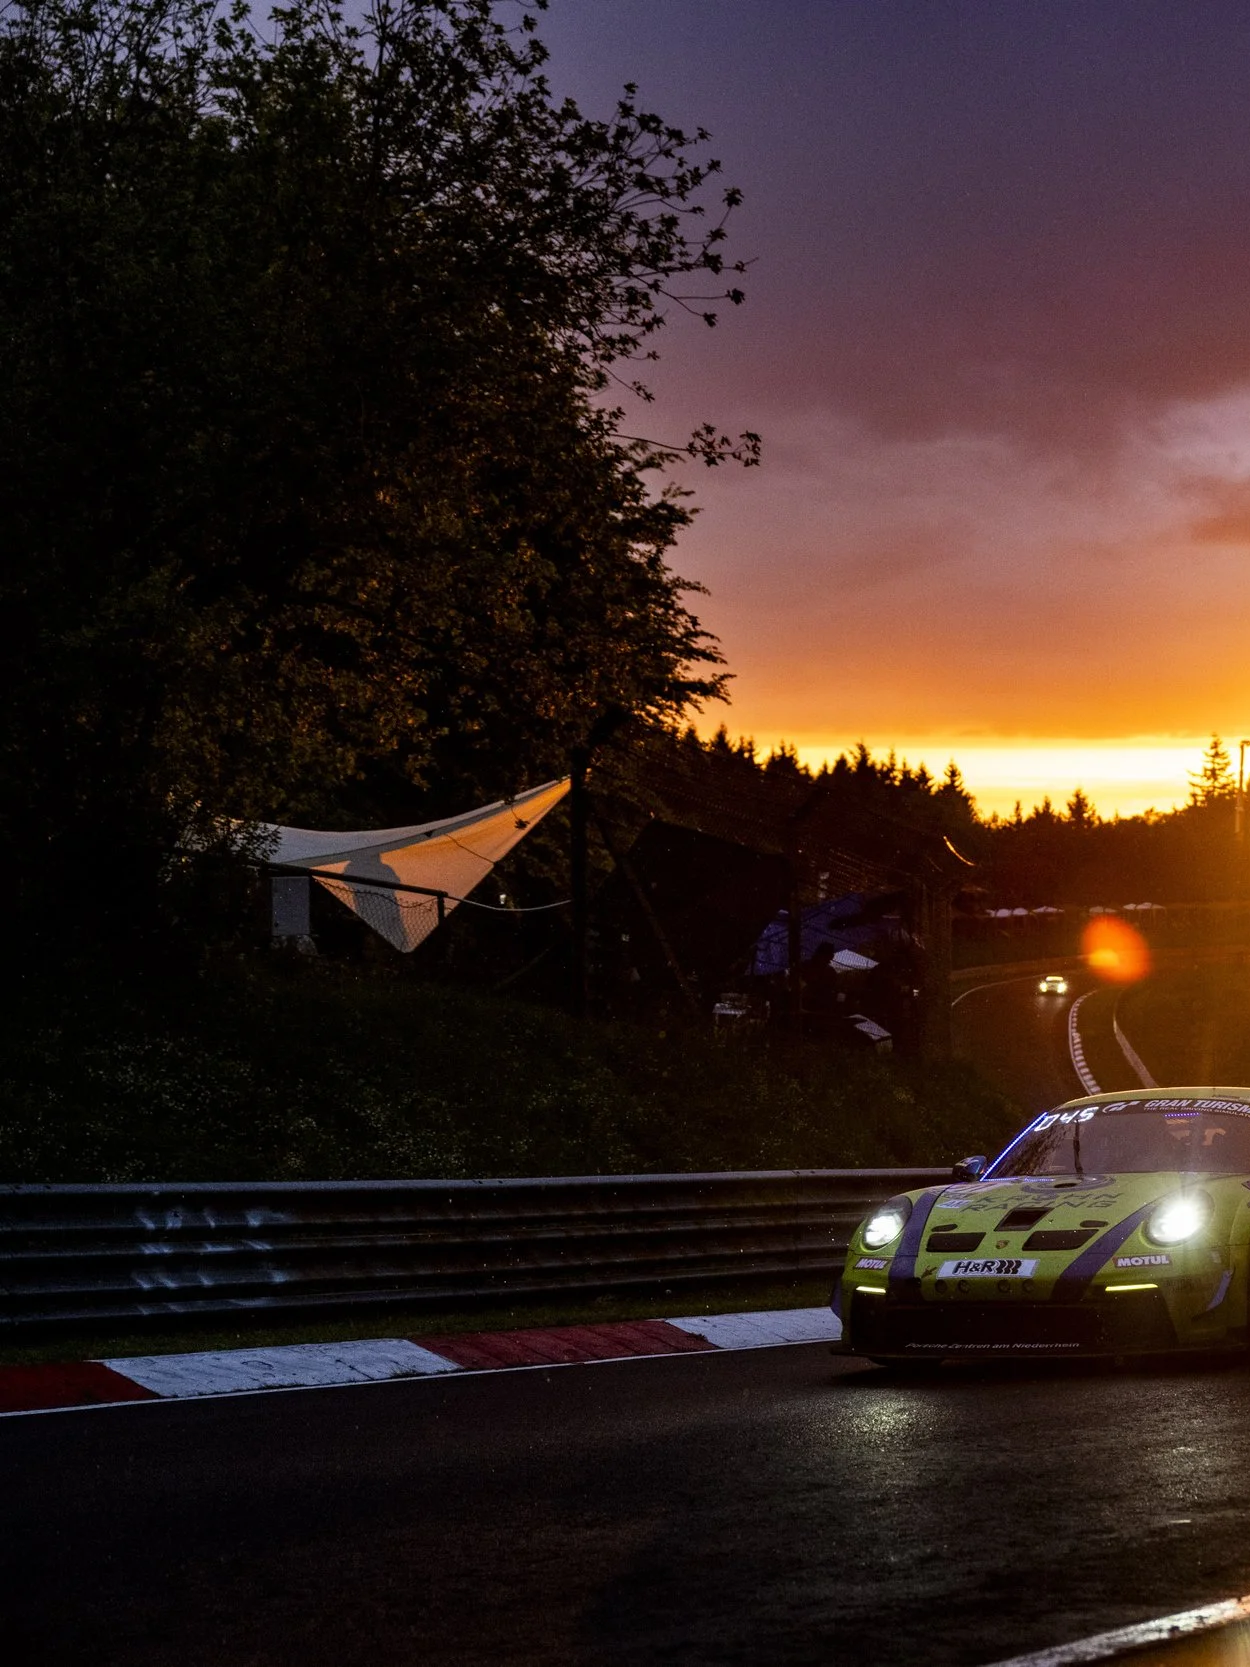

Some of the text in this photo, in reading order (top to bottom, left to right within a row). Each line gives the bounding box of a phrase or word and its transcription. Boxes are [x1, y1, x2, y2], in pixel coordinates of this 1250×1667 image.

[1144, 1099, 1193, 1108] GRAN
[855, 1258, 888, 1269] MOTUL
[1117, 1255, 1170, 1267] MOTUL
[952, 1260, 997, 1275] H&R
